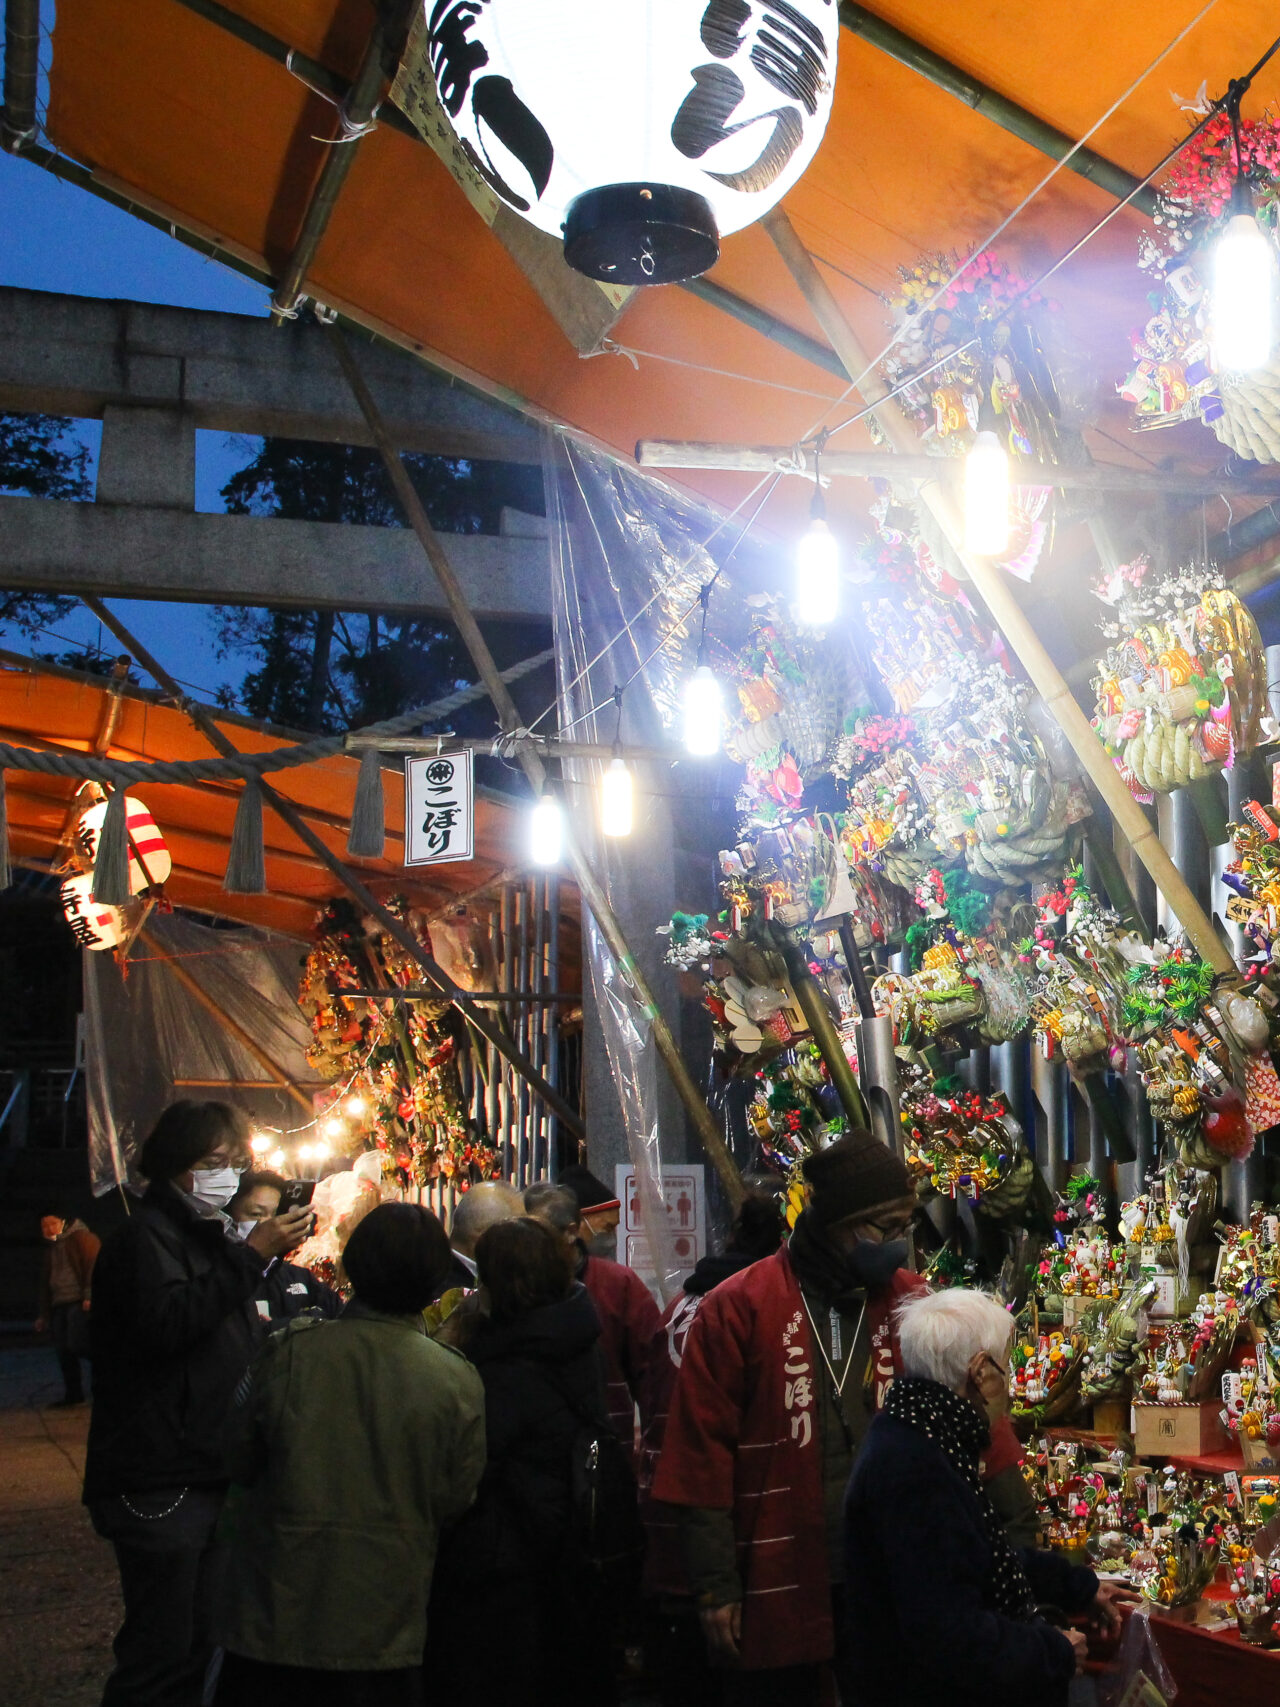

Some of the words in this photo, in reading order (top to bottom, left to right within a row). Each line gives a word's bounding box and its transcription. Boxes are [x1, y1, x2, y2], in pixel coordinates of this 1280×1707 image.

[422, 786, 461, 856] こぼり
[783, 1311, 802, 1346] 宇都宮
[784, 1346, 813, 1448] こぼり
